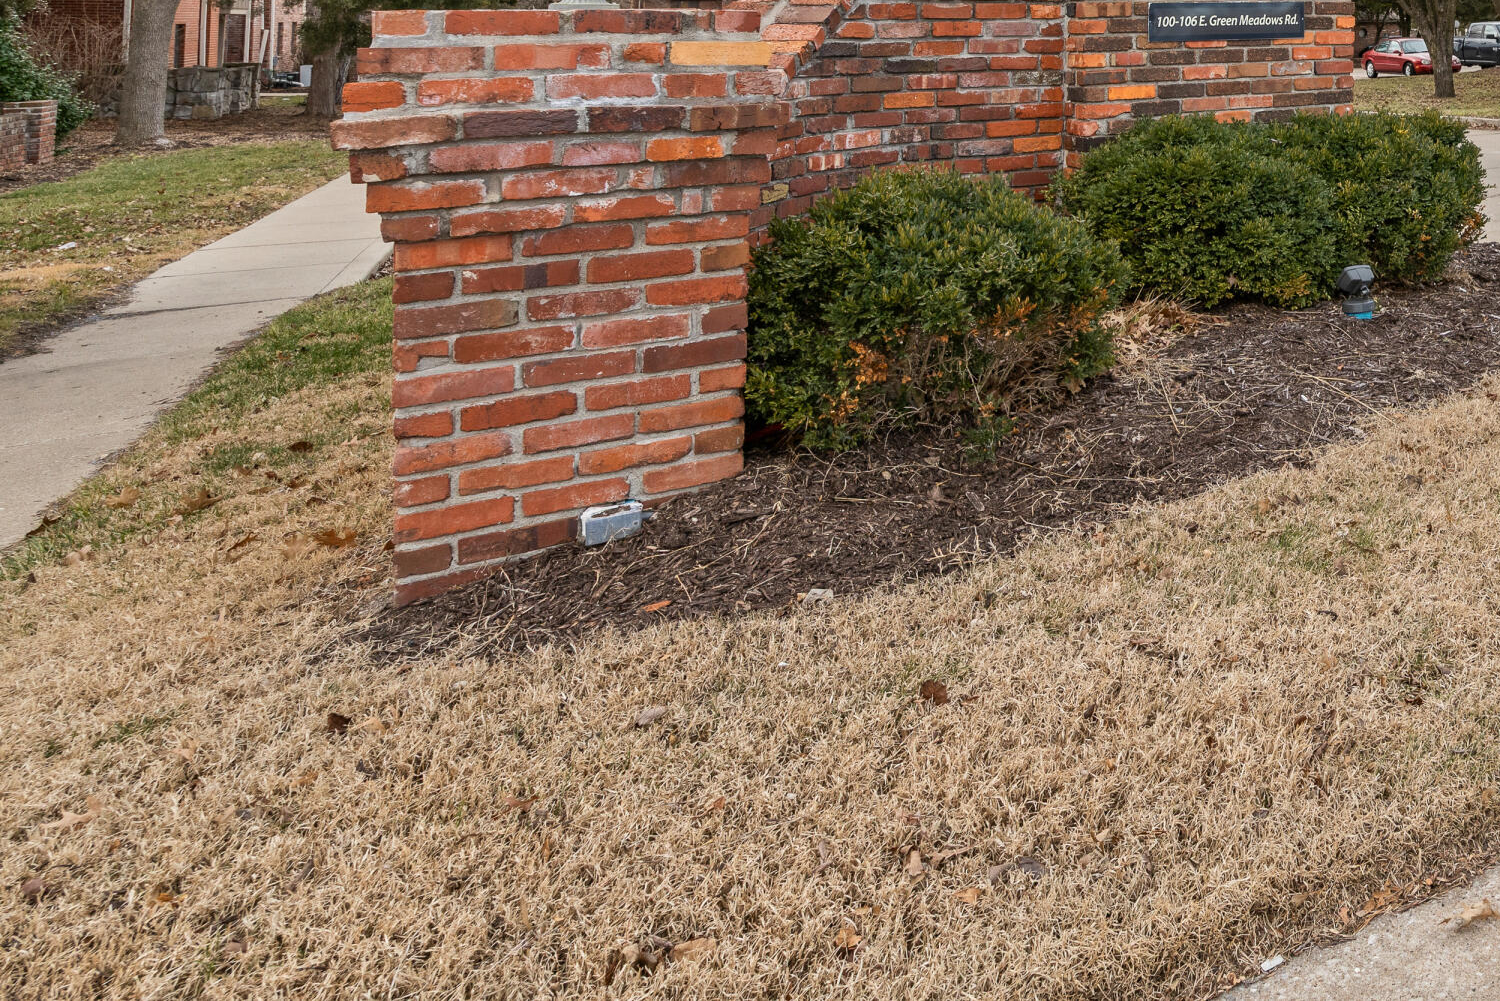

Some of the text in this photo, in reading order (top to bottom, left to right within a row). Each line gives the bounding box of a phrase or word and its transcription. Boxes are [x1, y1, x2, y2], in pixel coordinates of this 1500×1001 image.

[1157, 13, 1299, 28] 100-106 E. Green Meadows Rd.
